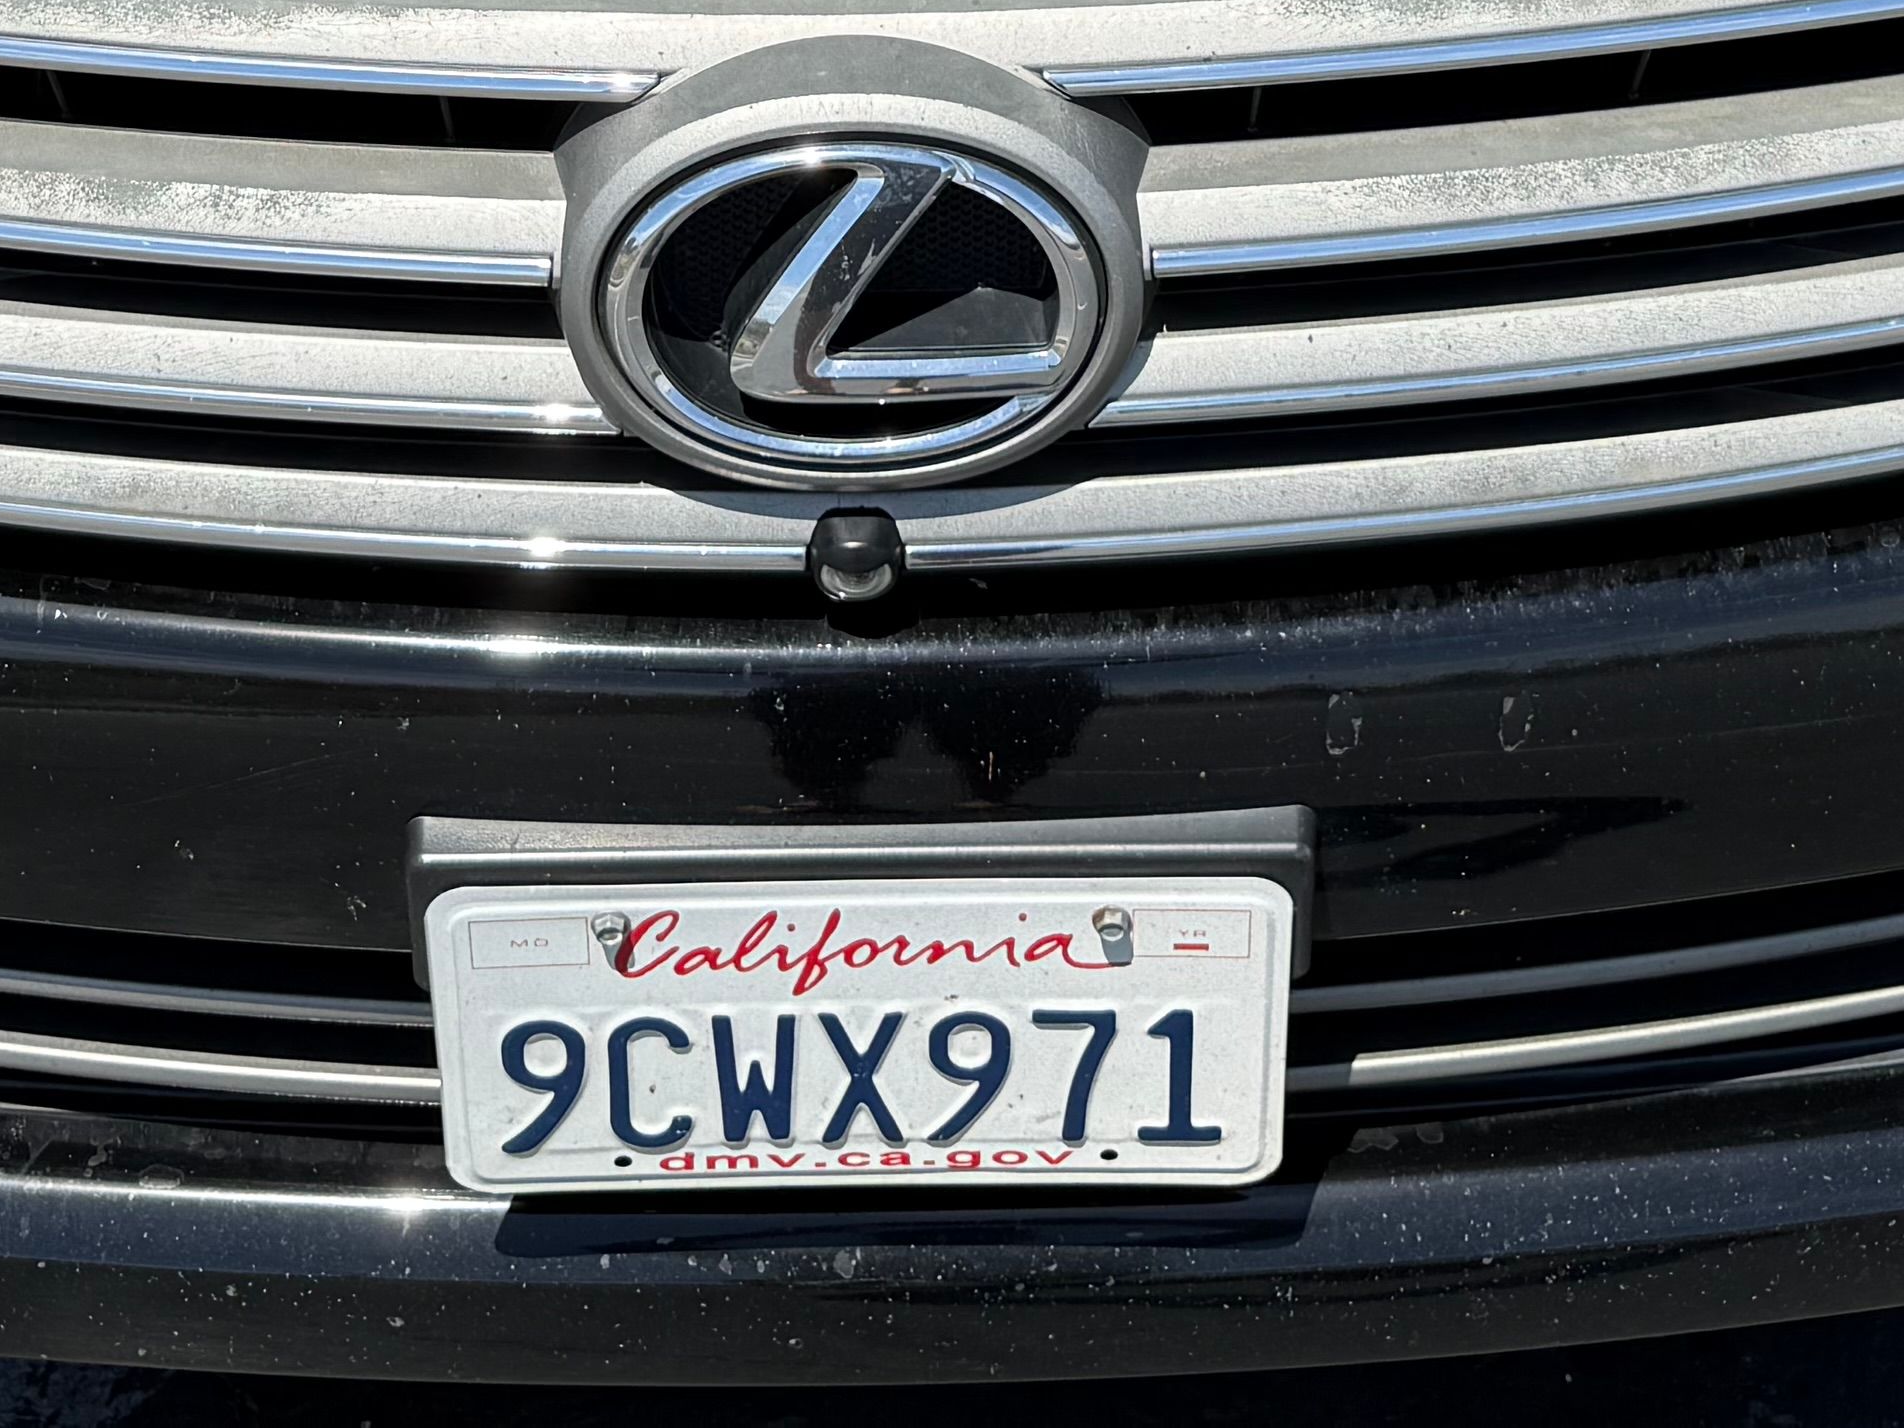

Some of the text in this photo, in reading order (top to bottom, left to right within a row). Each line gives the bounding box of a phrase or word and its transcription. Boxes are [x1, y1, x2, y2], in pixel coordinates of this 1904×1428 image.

[614, 909, 1130, 996] California
[501, 1009, 1222, 1153] 9CWX971
[659, 1148, 1075, 1171] dmv.ca.gov
